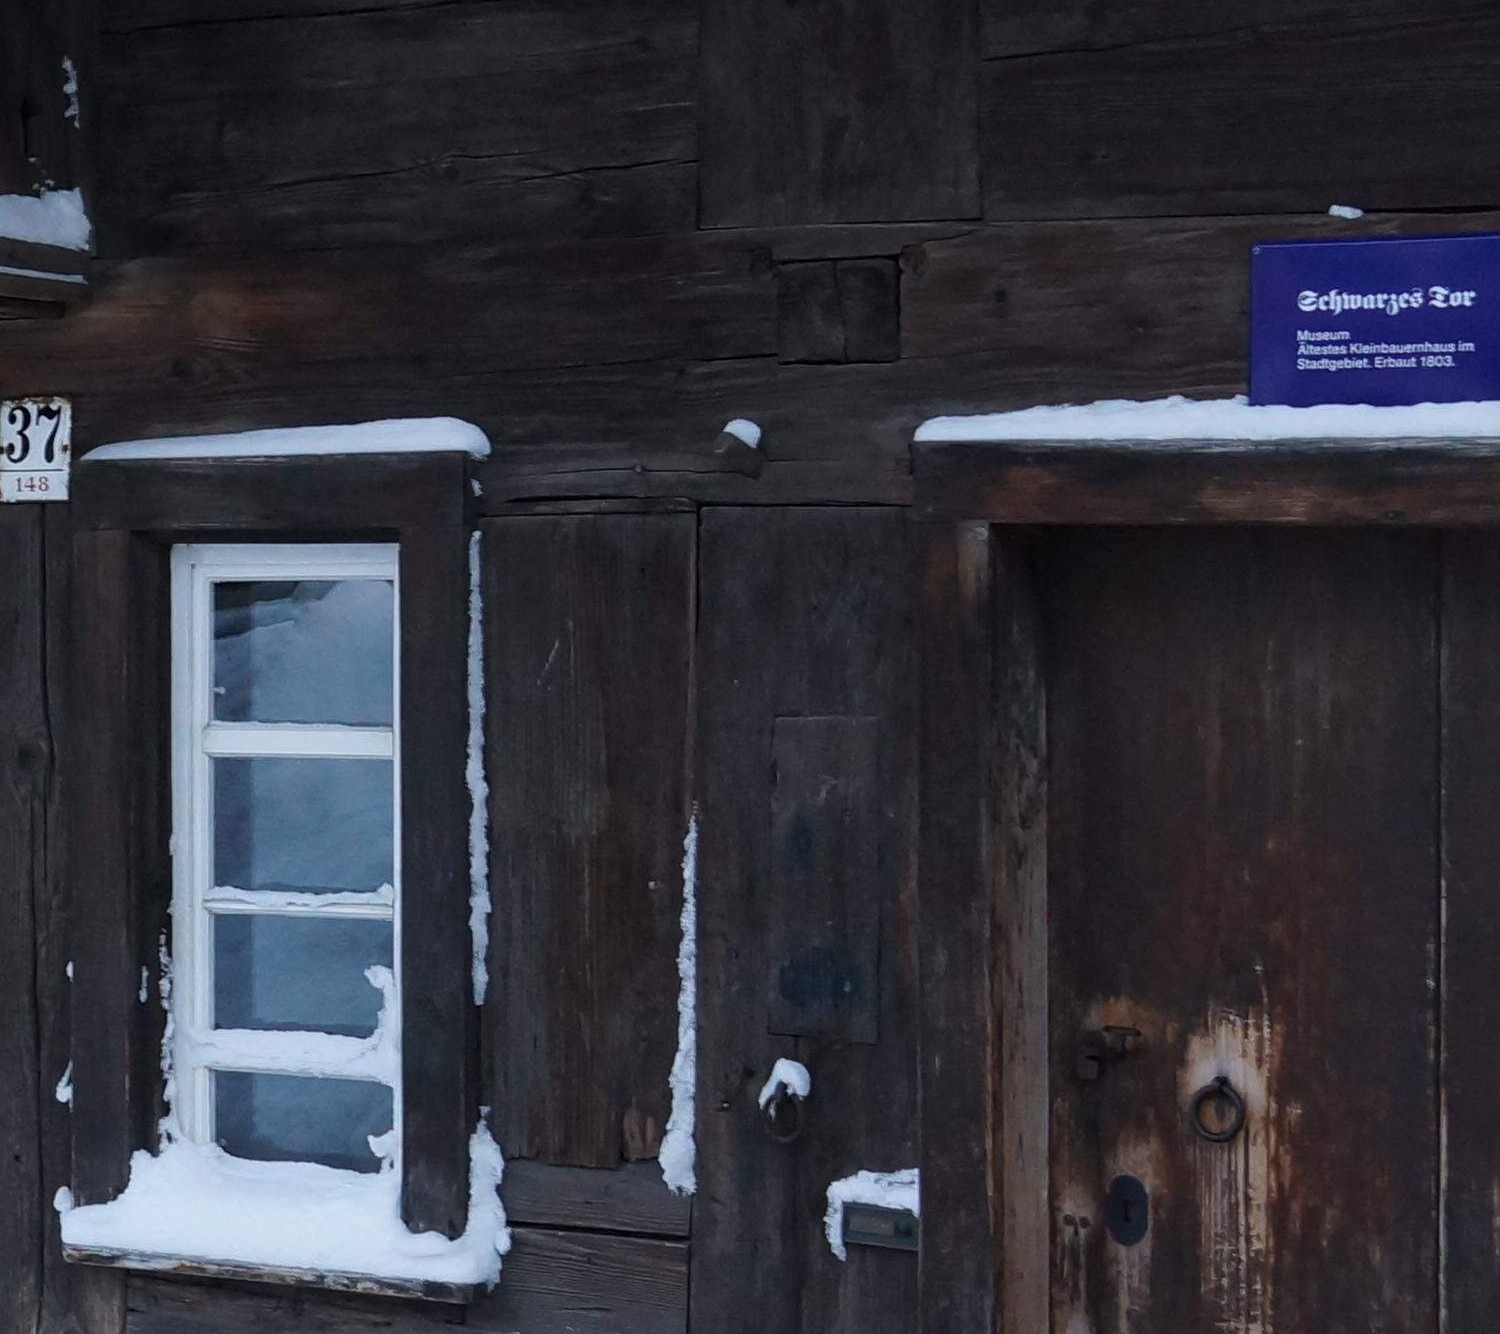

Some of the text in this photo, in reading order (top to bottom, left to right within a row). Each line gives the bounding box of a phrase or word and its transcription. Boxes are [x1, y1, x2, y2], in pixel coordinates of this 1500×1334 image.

[1297, 285, 1477, 315] Schwarzes Tor
[1297, 330, 1350, 341] Museum
[1297, 340, 1475, 355] Ältestes Kleinbauernhaus im
[1297, 355, 1455, 371] Stadtgebiet. Erbaut 1803.
[6, 405, 62, 464] 37
[16, 476, 50, 493] 148
